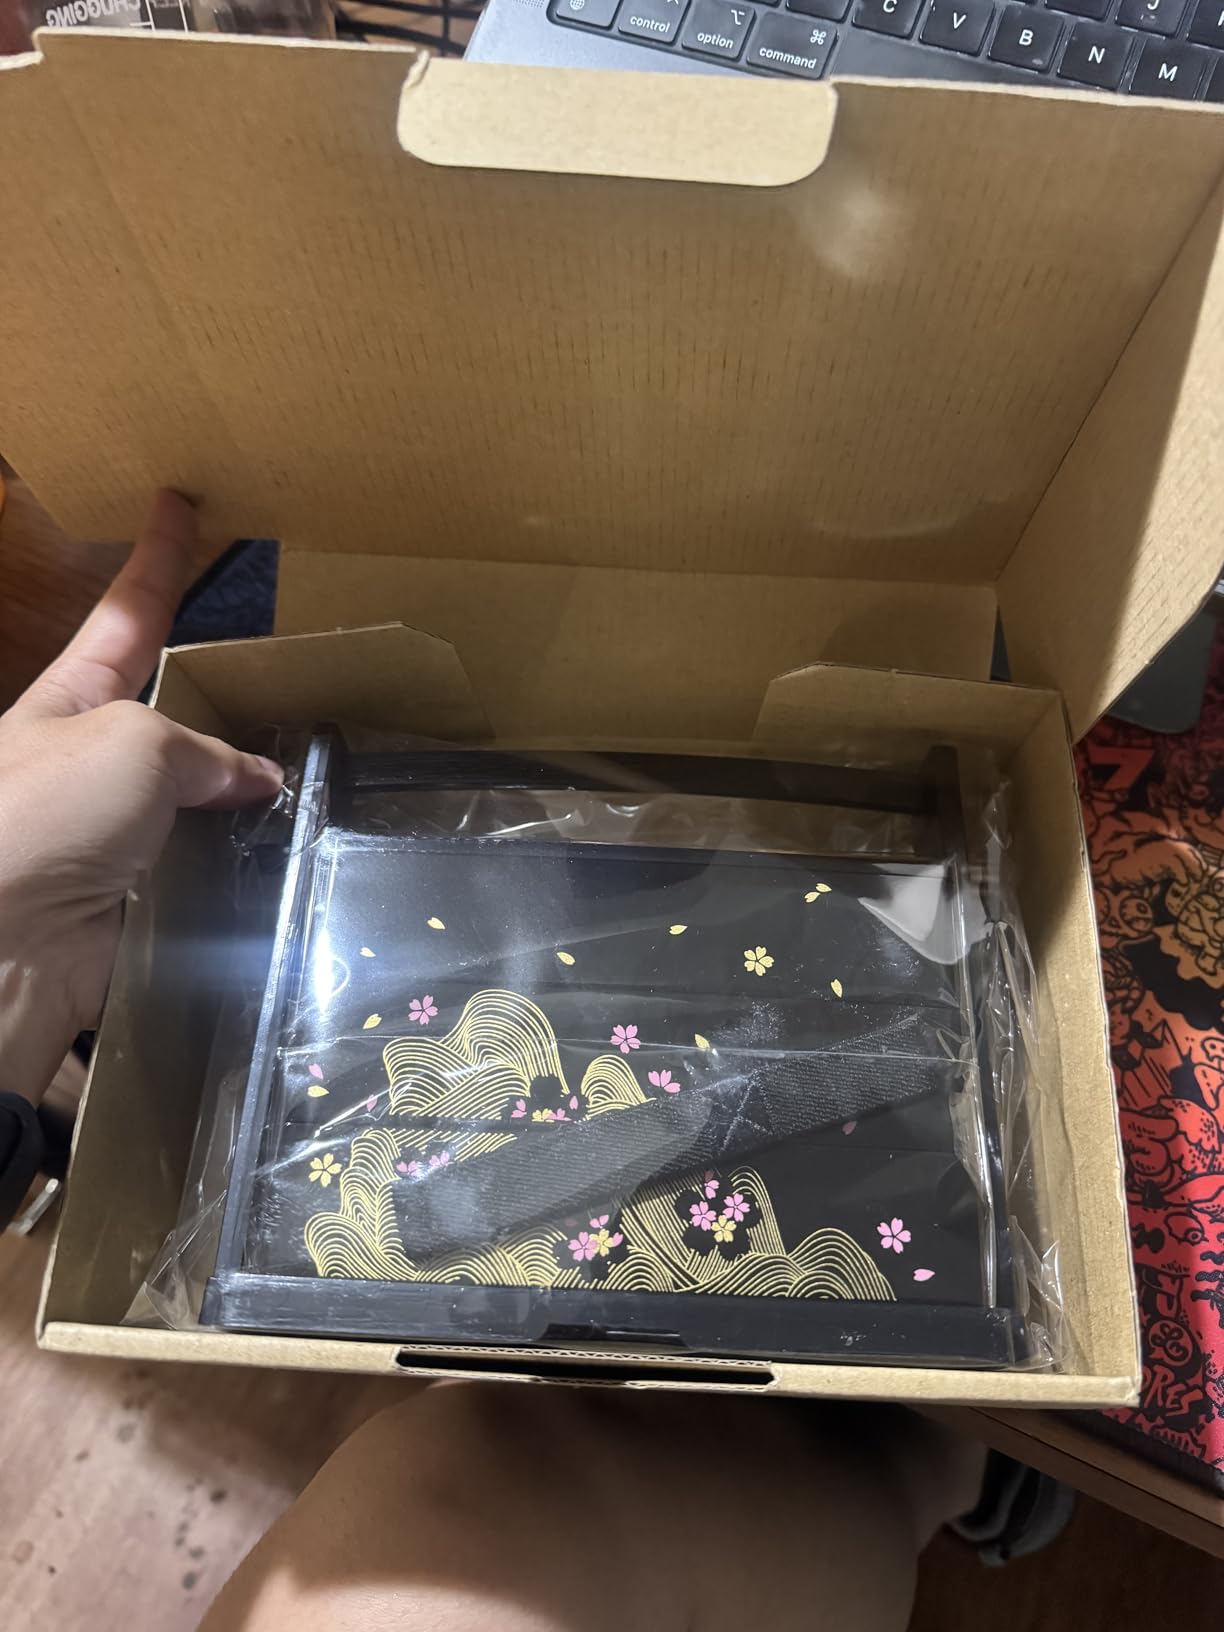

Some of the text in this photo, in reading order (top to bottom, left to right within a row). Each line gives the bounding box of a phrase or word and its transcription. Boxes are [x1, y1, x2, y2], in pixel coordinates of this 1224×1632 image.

[882, 0, 897, 13] C
[630, 15, 670, 33] control
[953, 12, 967, 29] V
[697, 32, 734, 49] option
[1018, 29, 1034, 46] B
[759, 47, 817, 69] command
[1088, 45, 1105, 64] N
[1158, 62, 1178, 82] M
